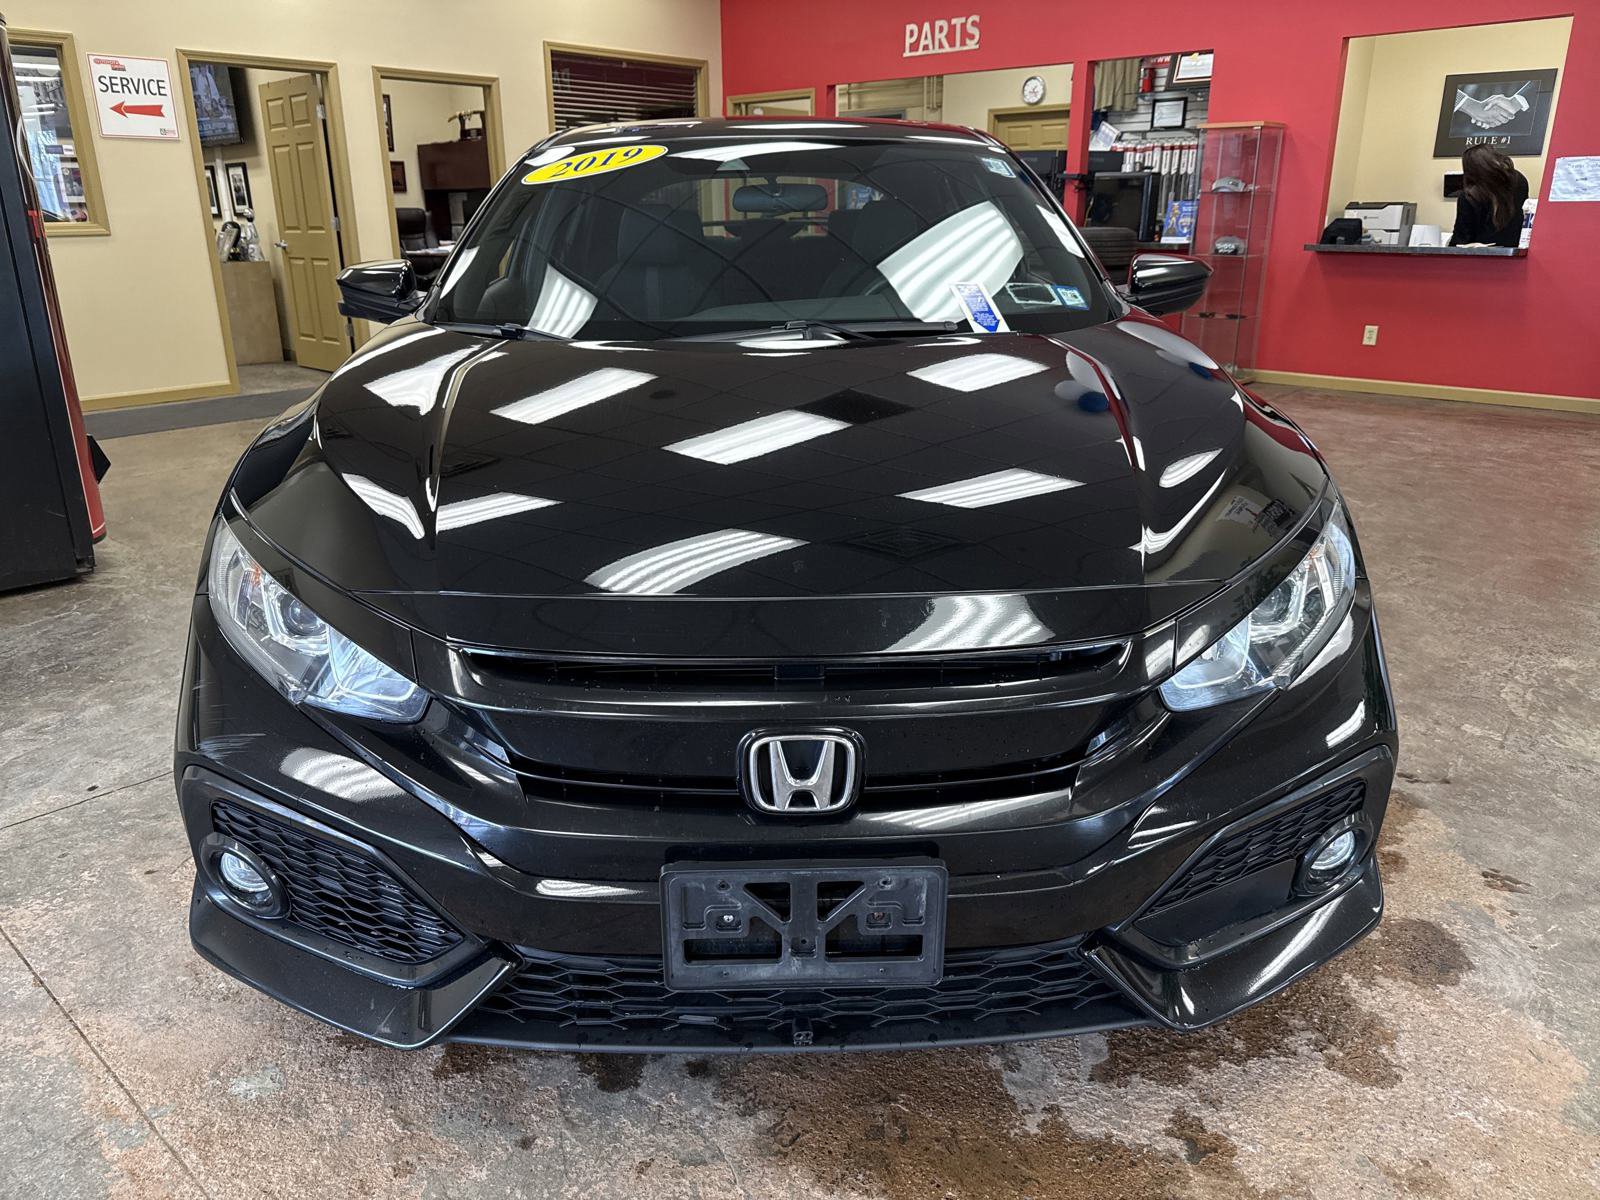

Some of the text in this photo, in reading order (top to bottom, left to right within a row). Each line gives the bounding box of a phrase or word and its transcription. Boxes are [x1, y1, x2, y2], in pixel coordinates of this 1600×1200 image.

[903, 14, 980, 56] PARTS
[97, 75, 168, 97] SERVICE
[1465, 135, 1511, 146] RULE #1
[549, 147, 643, 178] 2019
